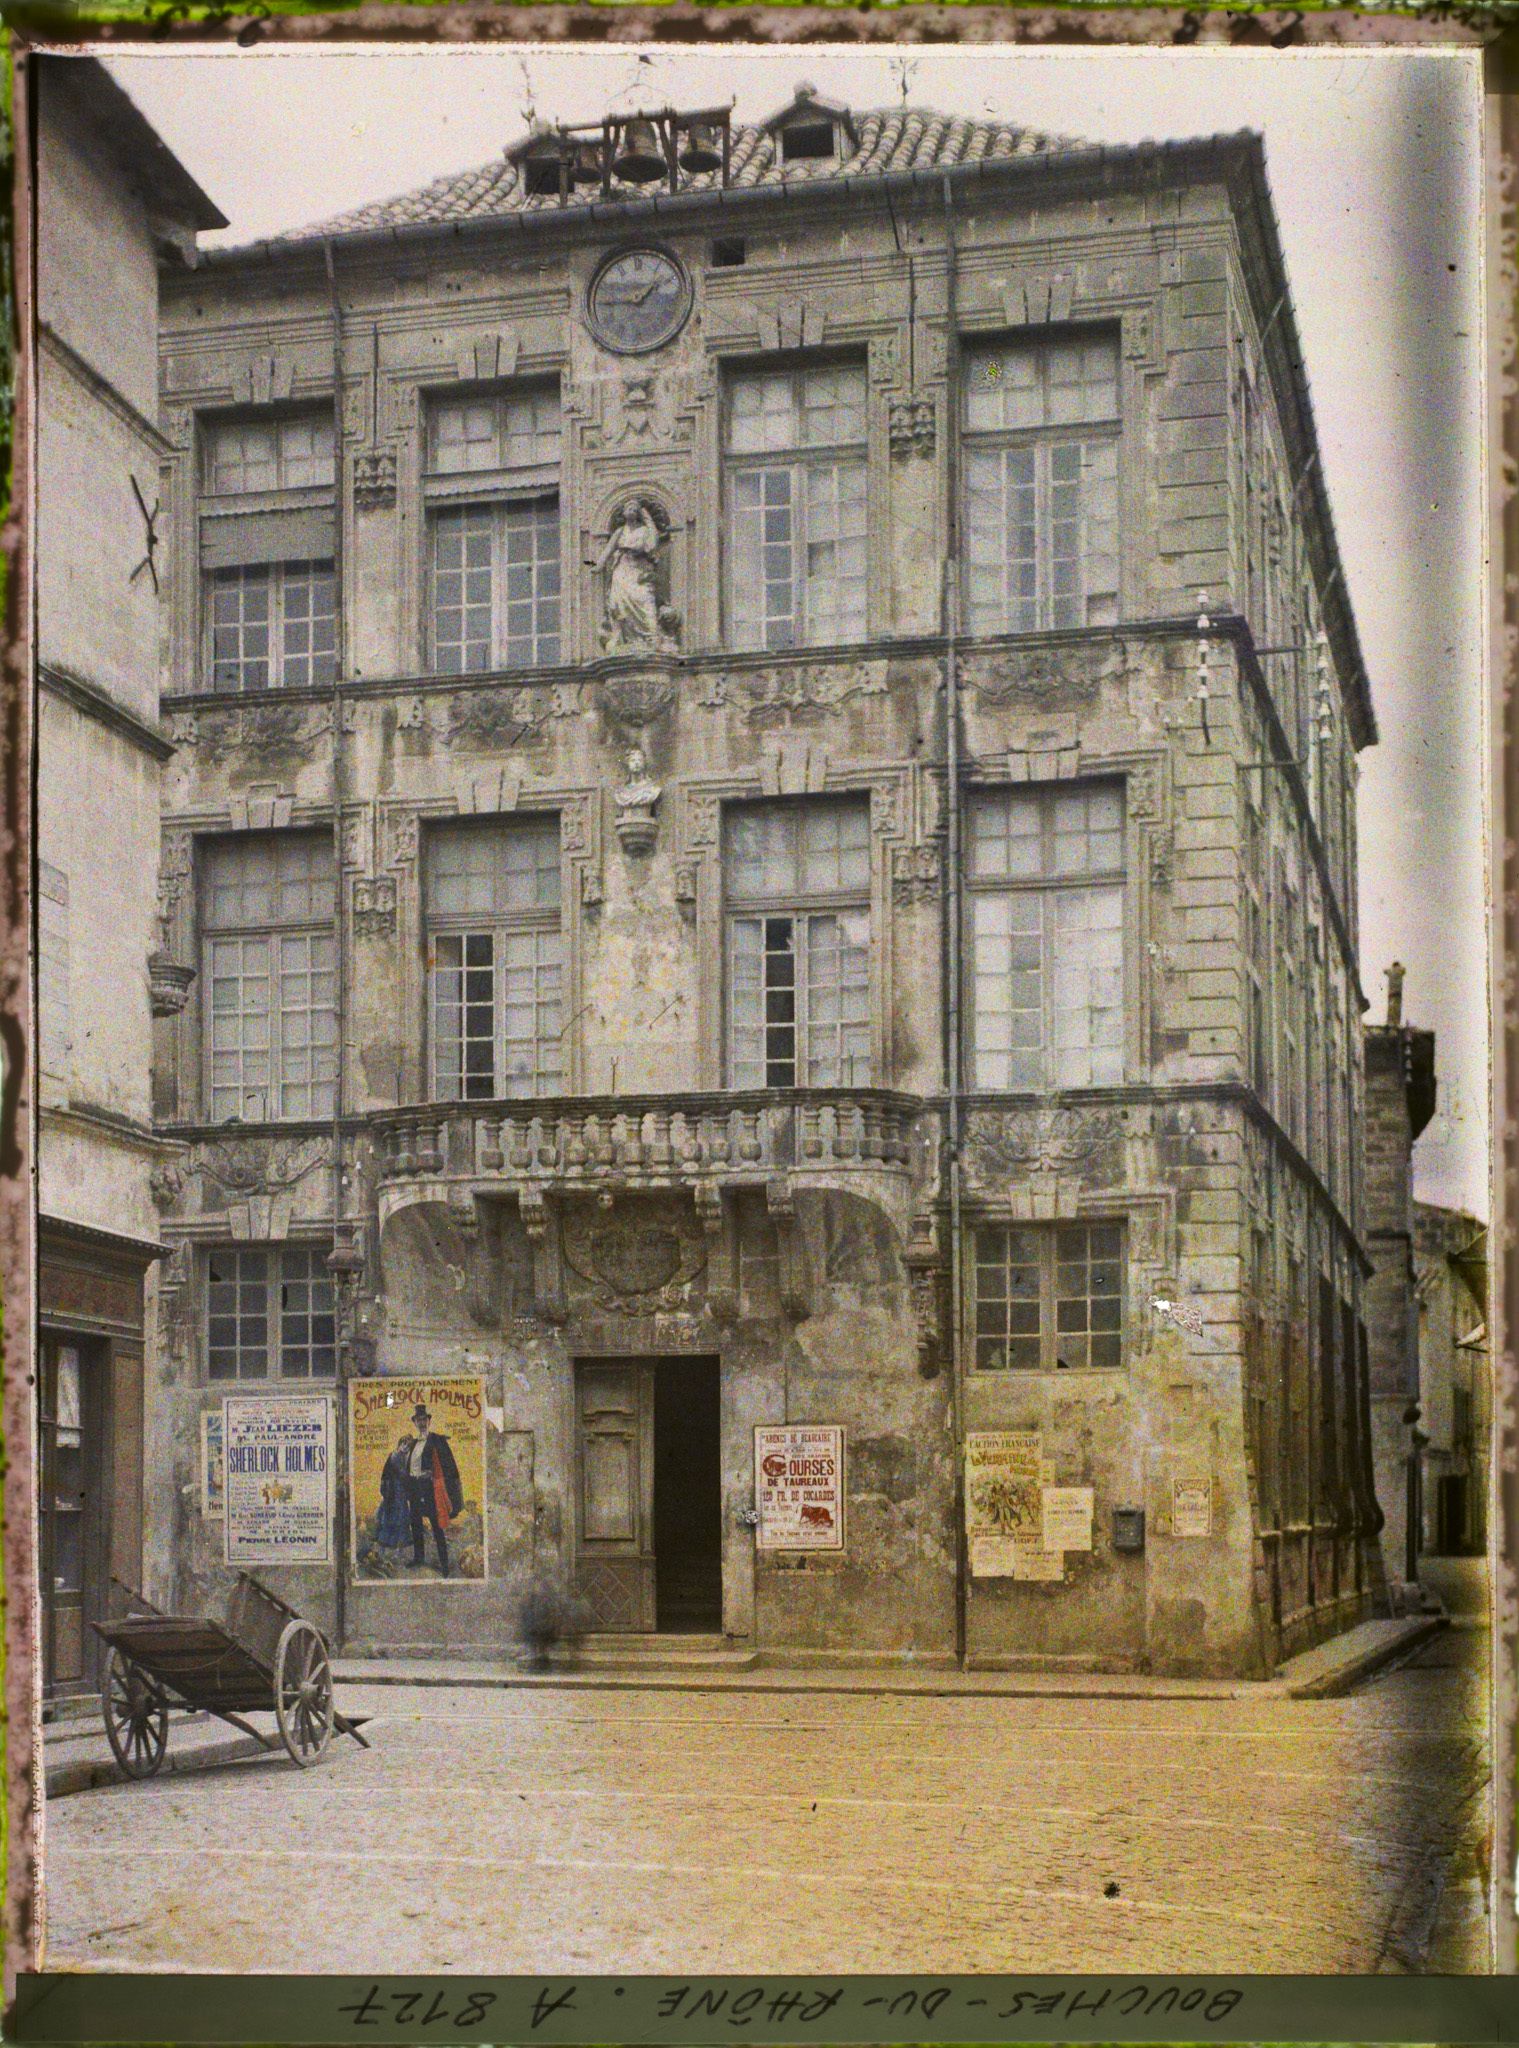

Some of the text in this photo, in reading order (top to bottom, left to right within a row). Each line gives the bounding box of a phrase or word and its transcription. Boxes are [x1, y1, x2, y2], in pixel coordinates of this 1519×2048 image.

[390, 1379, 479, 1388] PROCHAINEMENT
[430, 1388, 482, 1419] HOLMES
[229, 1445, 325, 1473] SHERLOCK HOLMES
[762, 1454, 834, 1477] COURSES
[767, 1477, 829, 1487] DE TAUREAUX
